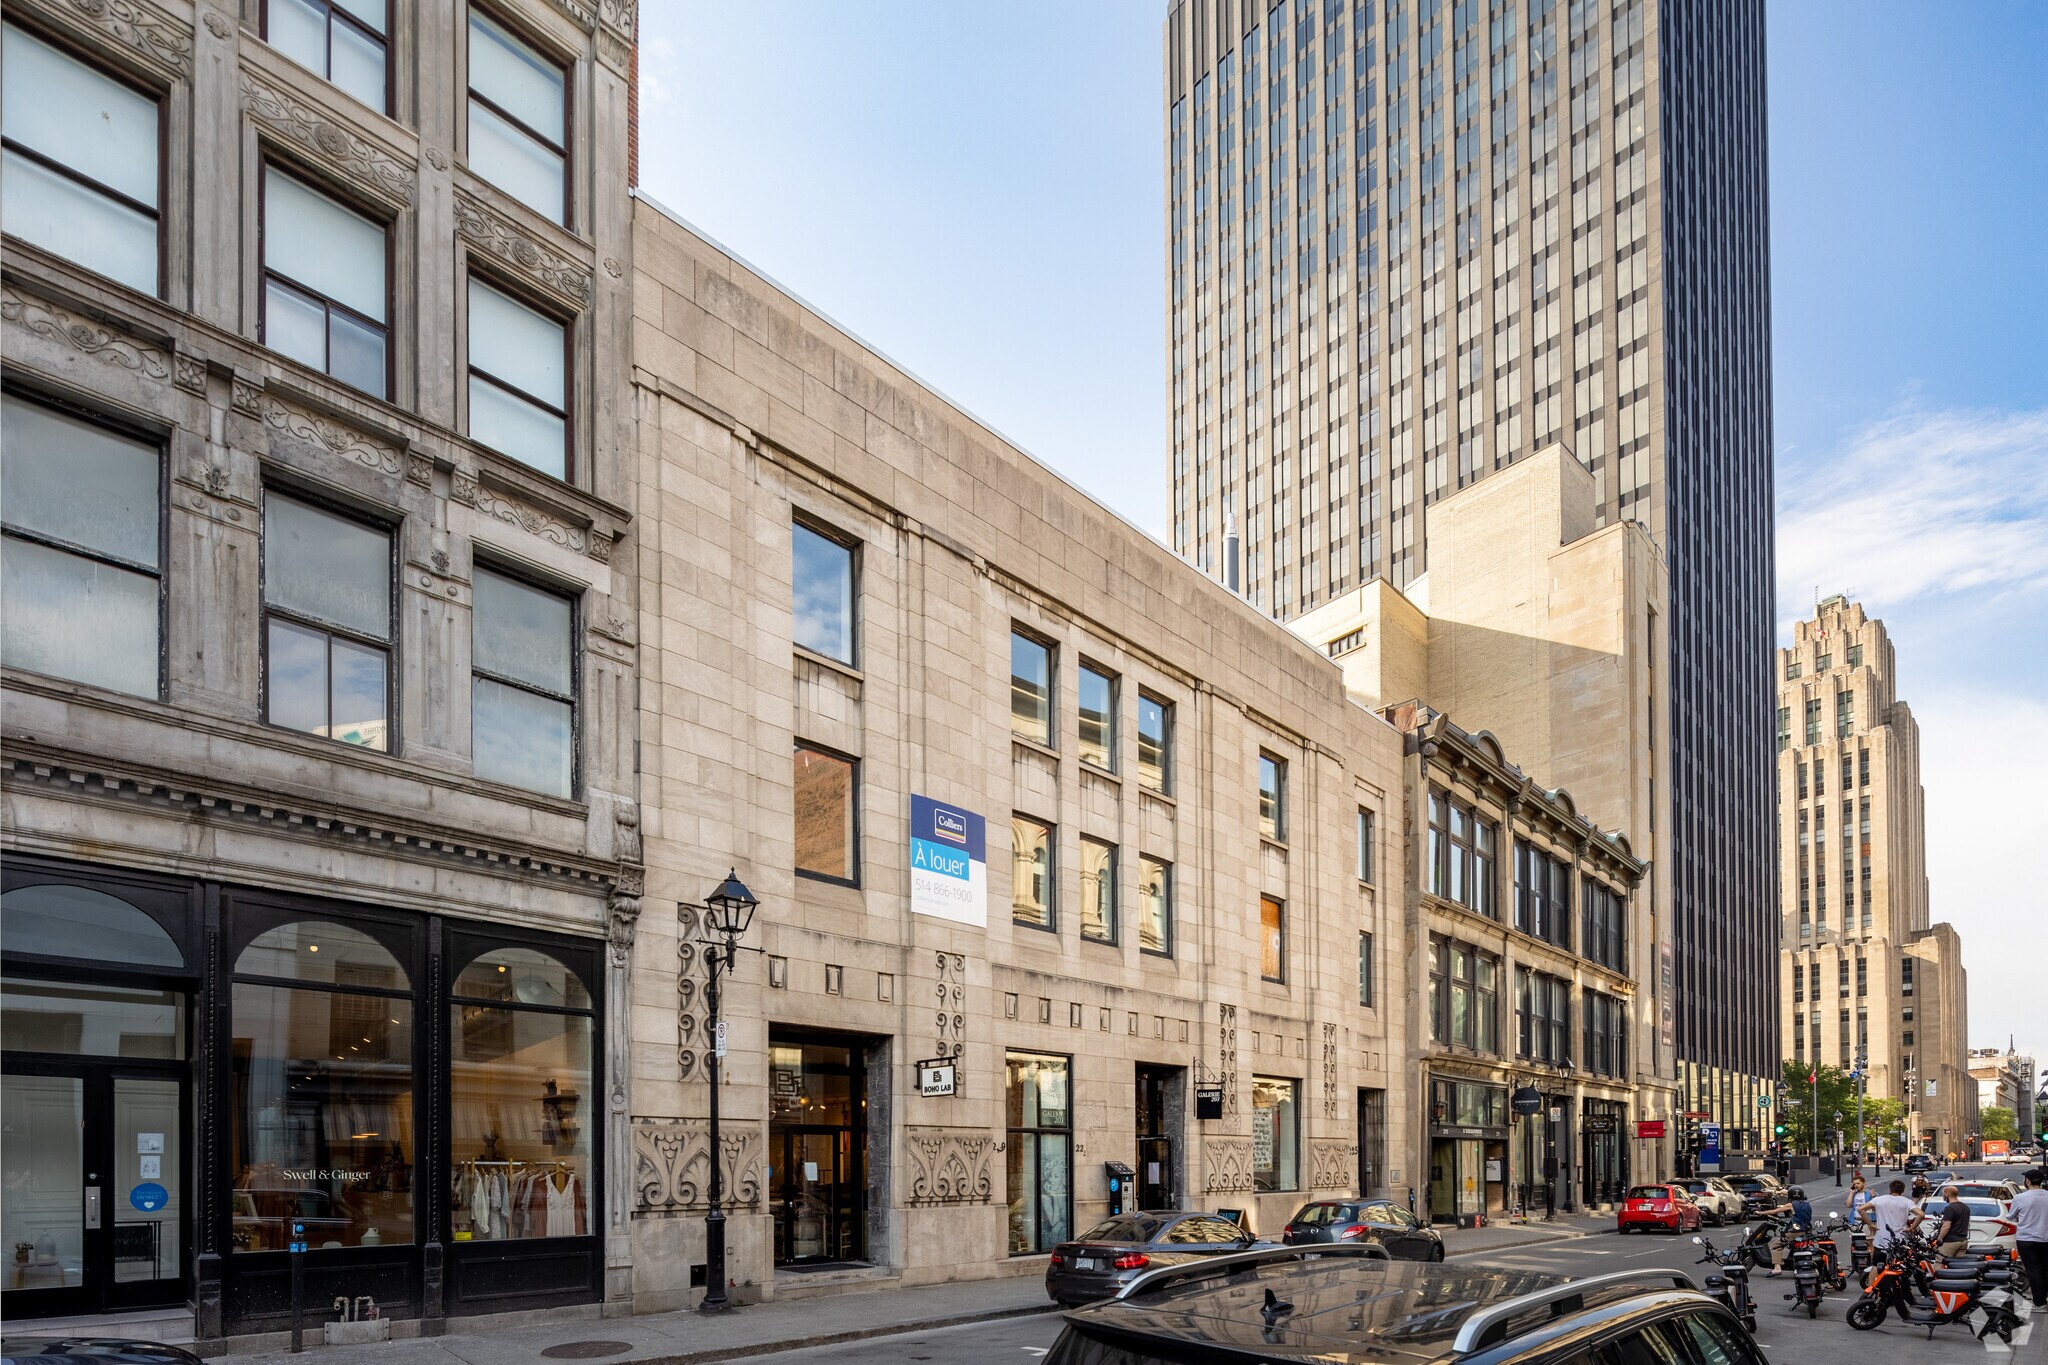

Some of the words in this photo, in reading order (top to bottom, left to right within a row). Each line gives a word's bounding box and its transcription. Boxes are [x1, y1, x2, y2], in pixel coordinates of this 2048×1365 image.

[938, 816, 963, 832] Colliers
[915, 841, 927, 867] À
[930, 848, 965, 876] louer
[915, 878, 931, 892] 514
[934, 882, 972, 903] 866-1900
[924, 1085, 940, 1093] BOHO
[940, 1084, 952, 1092] LAB
[283, 1169, 317, 1180] Swell
[318, 1169, 330, 1180] &
[331, 1169, 371, 1182] Ginger
